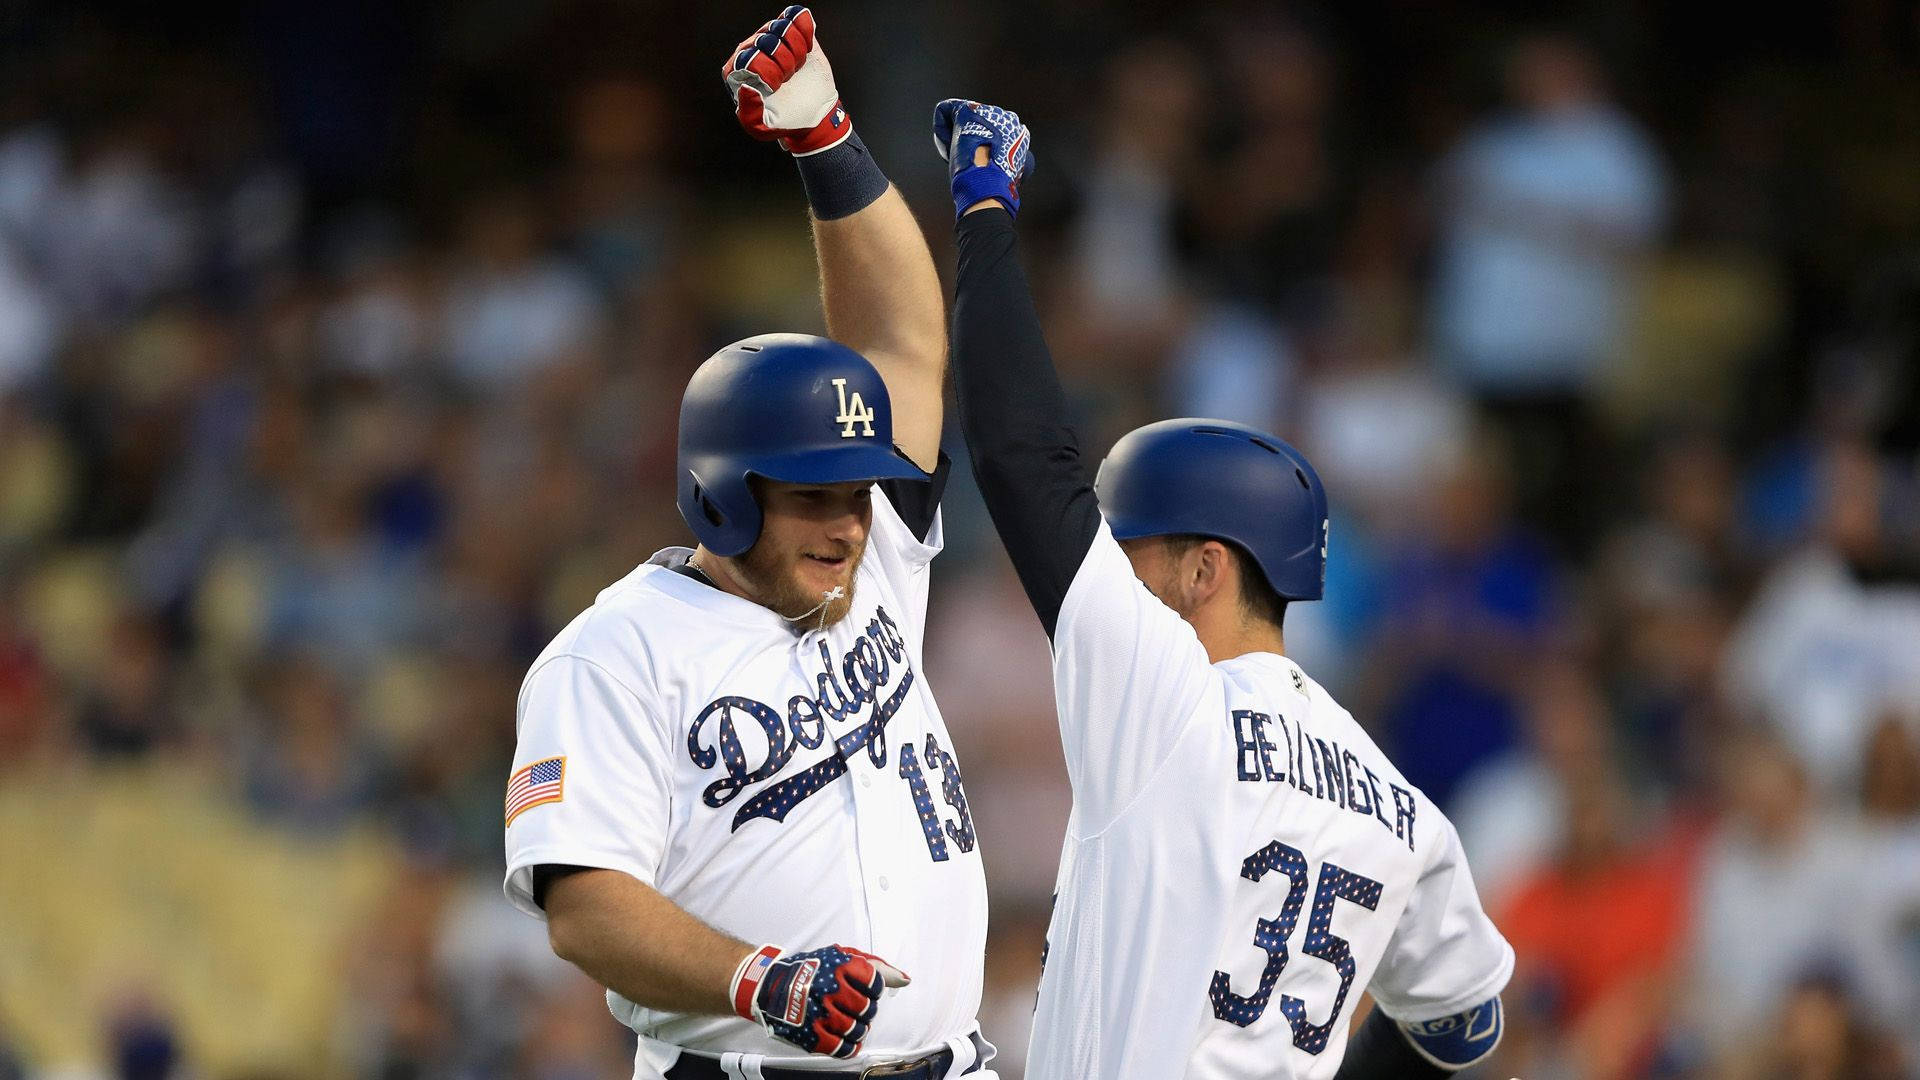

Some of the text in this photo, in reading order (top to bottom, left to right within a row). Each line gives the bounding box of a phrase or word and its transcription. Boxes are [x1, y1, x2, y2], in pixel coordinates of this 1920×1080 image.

[831, 378, 875, 437] LA
[687, 605, 906, 808] Dodgers
[898, 732, 975, 863] 13
[1231, 709, 1416, 852] BELLINGER
[1208, 839, 1384, 1055] 35
